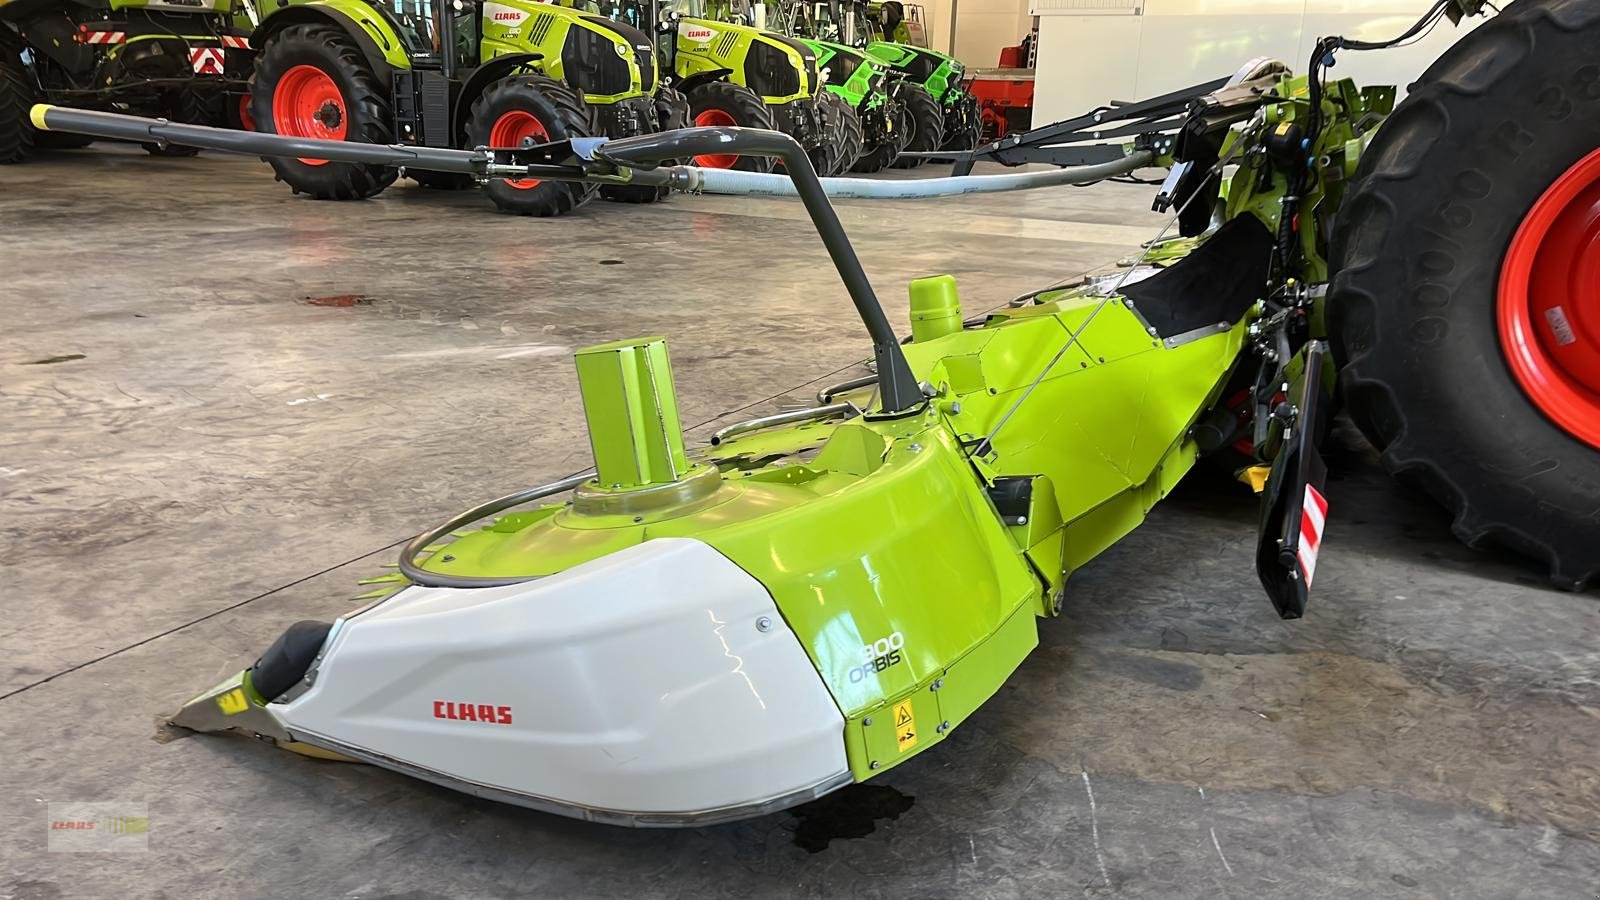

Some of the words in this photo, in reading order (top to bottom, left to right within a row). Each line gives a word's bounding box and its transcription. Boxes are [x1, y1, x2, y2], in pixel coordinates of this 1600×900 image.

[494, 12, 521, 20] CLAAS
[849, 649, 901, 684] ORBIS
[433, 700, 512, 725] CLAAS
